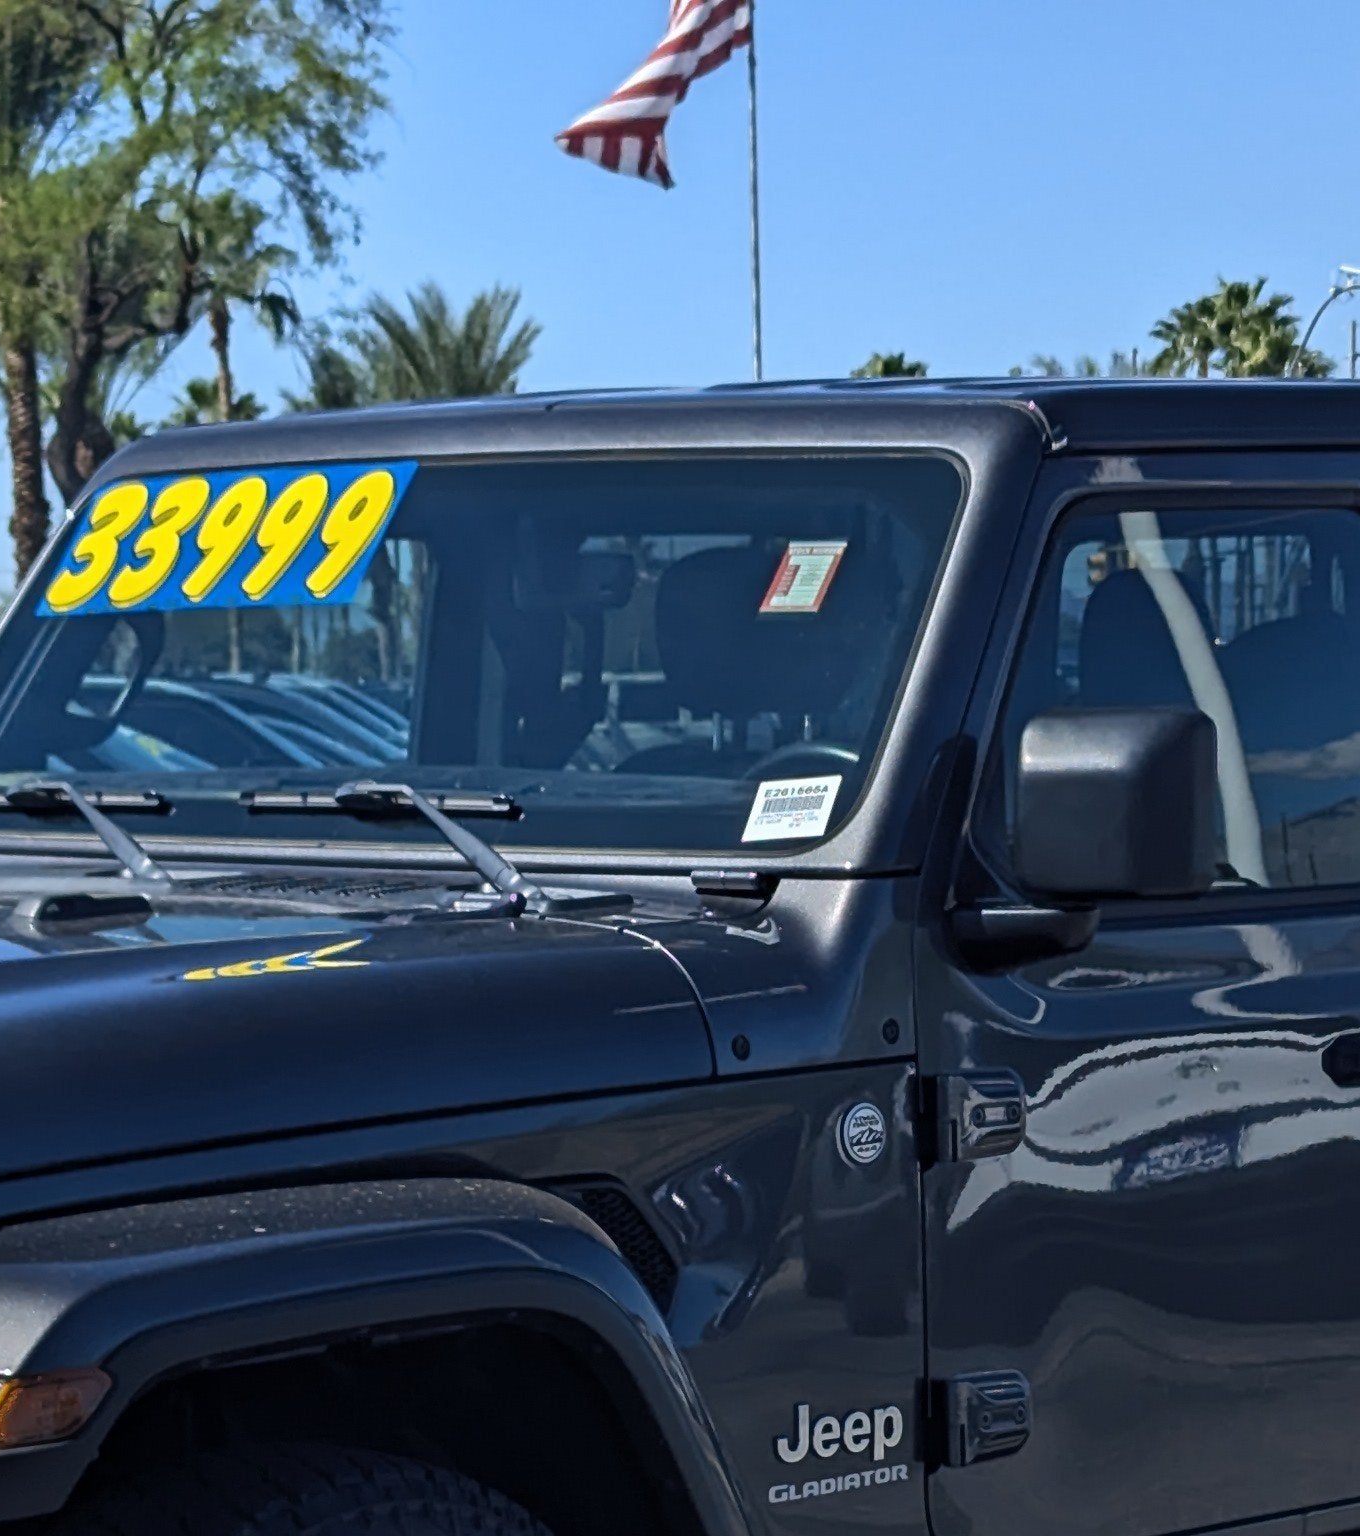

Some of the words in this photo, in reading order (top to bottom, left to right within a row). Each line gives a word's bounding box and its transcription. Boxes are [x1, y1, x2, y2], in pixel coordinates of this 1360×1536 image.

[45, 469, 396, 613] 33999
[777, 1404, 903, 1463] Jeep
[768, 1464, 909, 1503] GLADIATOR
